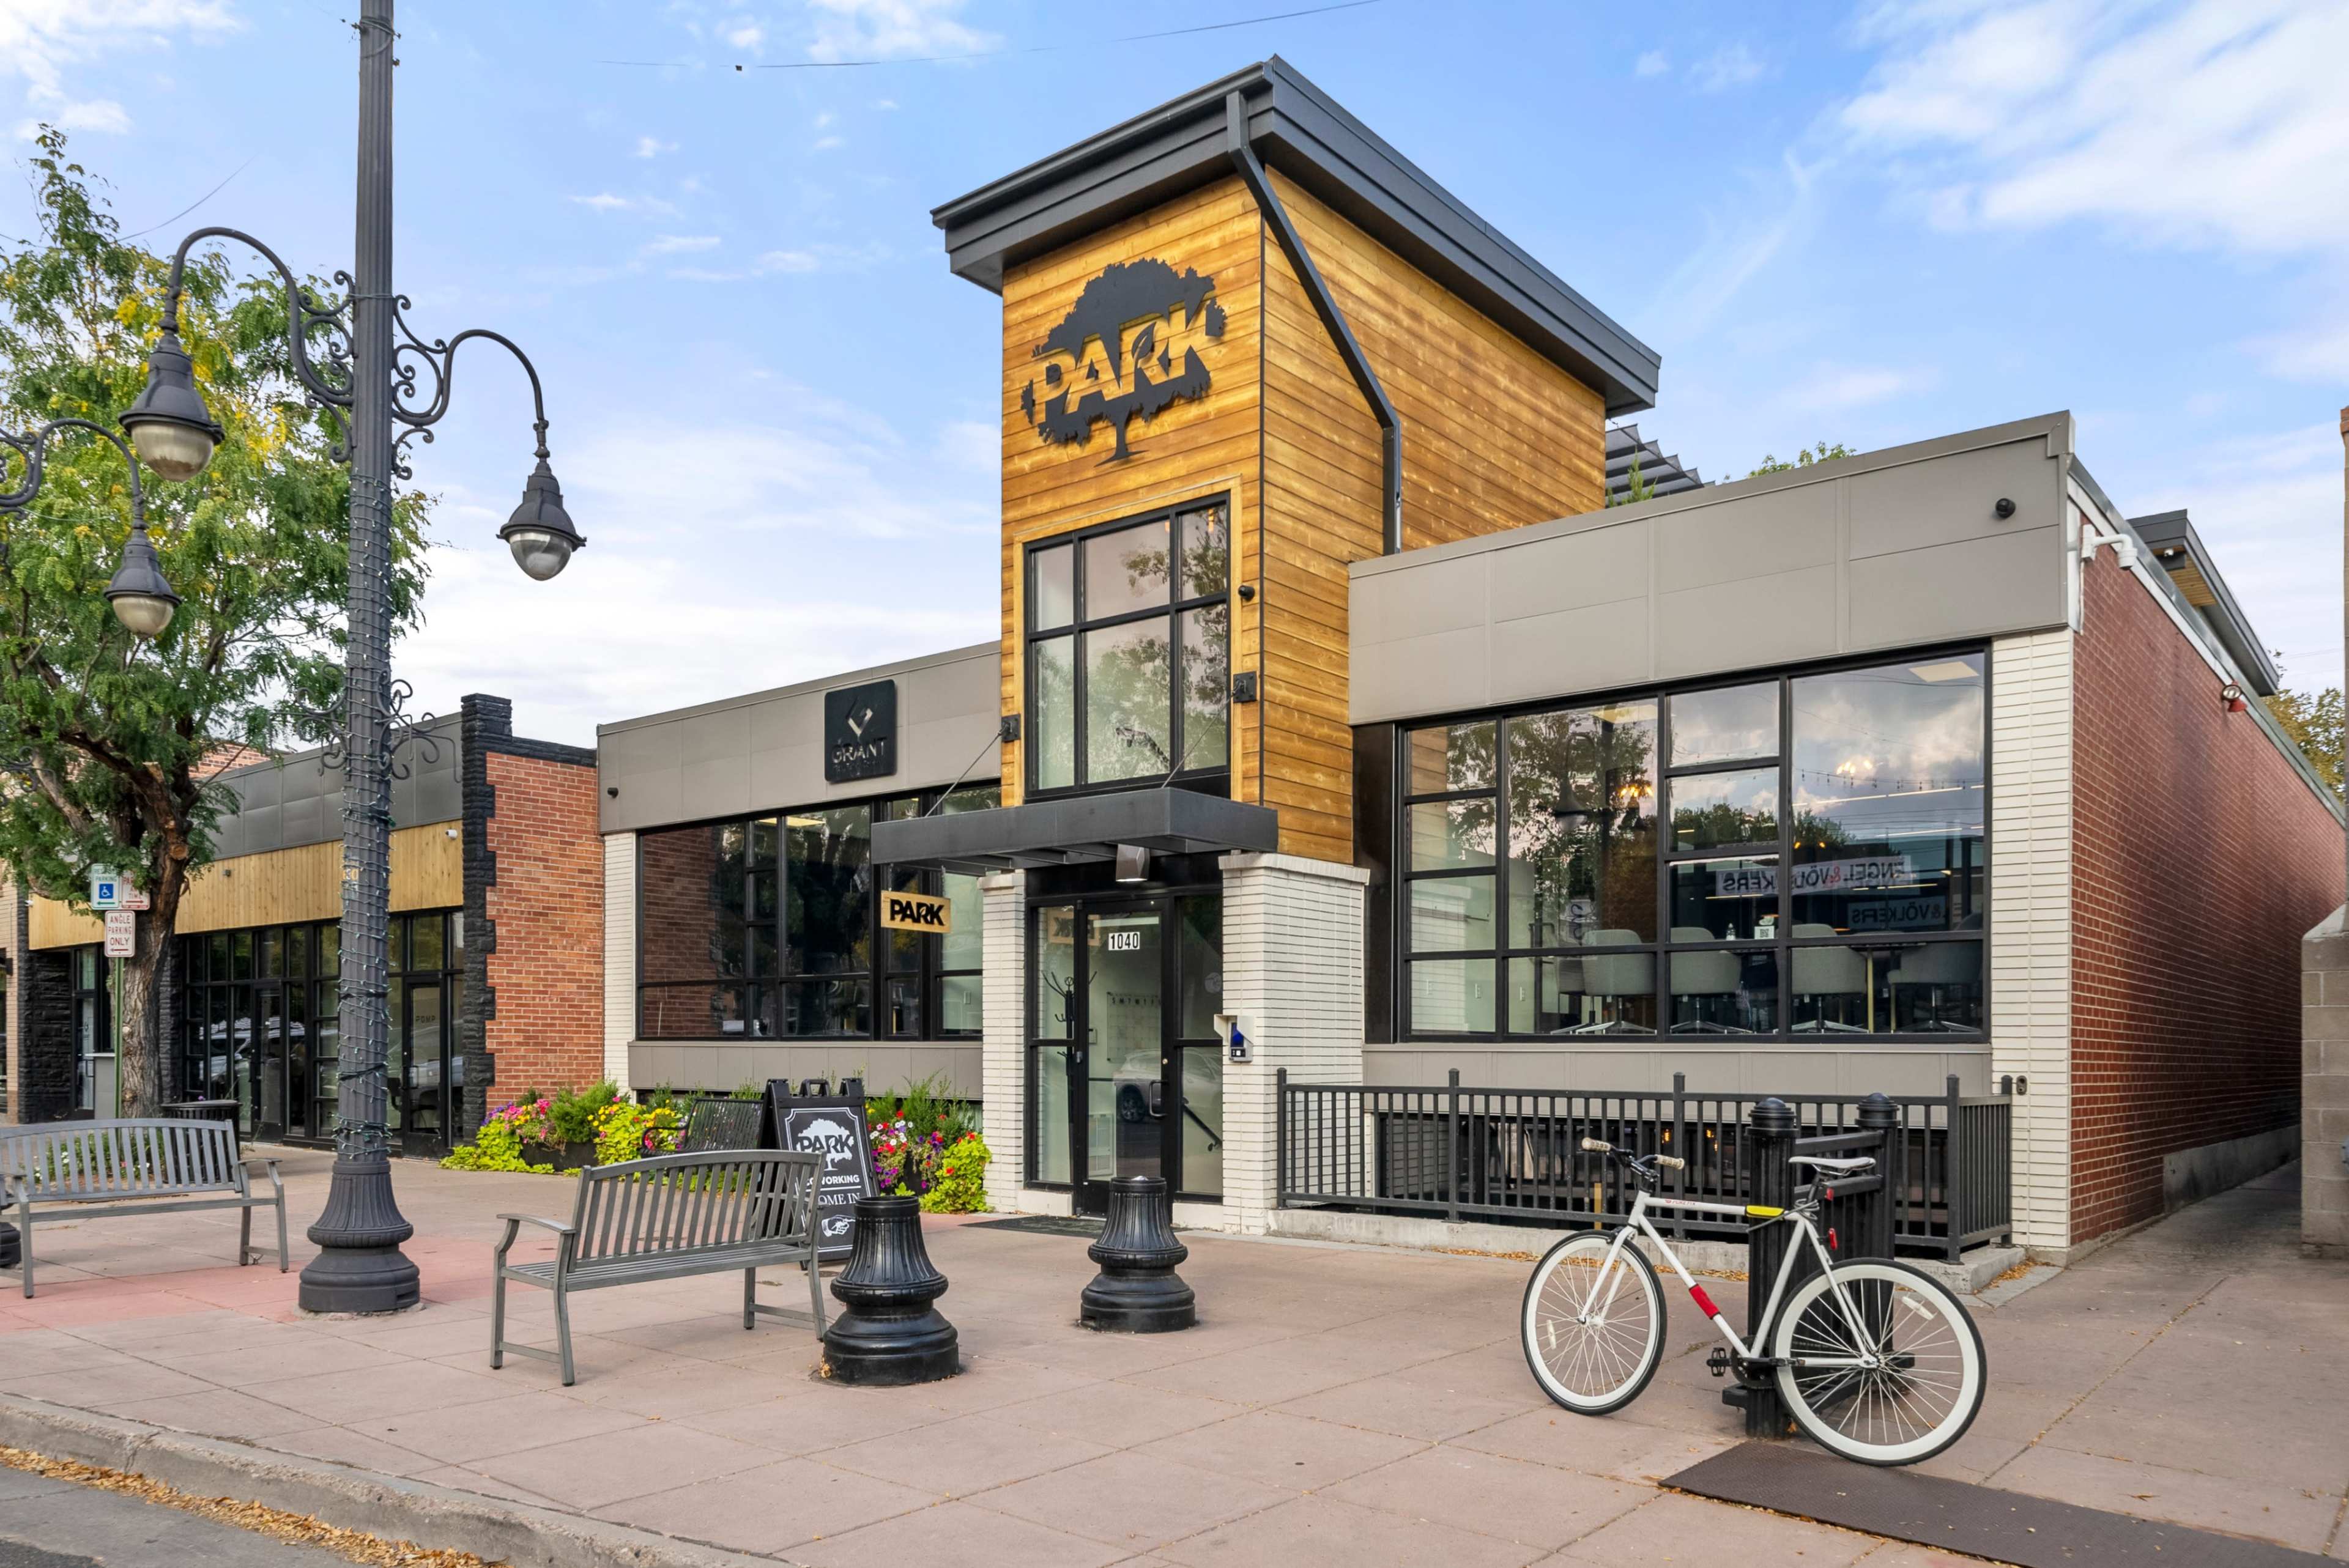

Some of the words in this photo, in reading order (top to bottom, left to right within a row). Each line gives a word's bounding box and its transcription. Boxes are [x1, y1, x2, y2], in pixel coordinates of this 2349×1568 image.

[1032, 290, 1215, 423] PARK
[832, 736, 888, 763] GRANT
[110, 915, 130, 924] ANGLE
[890, 899, 945, 926] PARK
[108, 926, 132, 935] PARKING
[109, 937, 130, 946] ONLY
[1110, 933, 1138, 949] 1040
[799, 1134, 853, 1154] PARK
[818, 1194, 846, 1205] OME
[847, 1193, 860, 1204] IN
